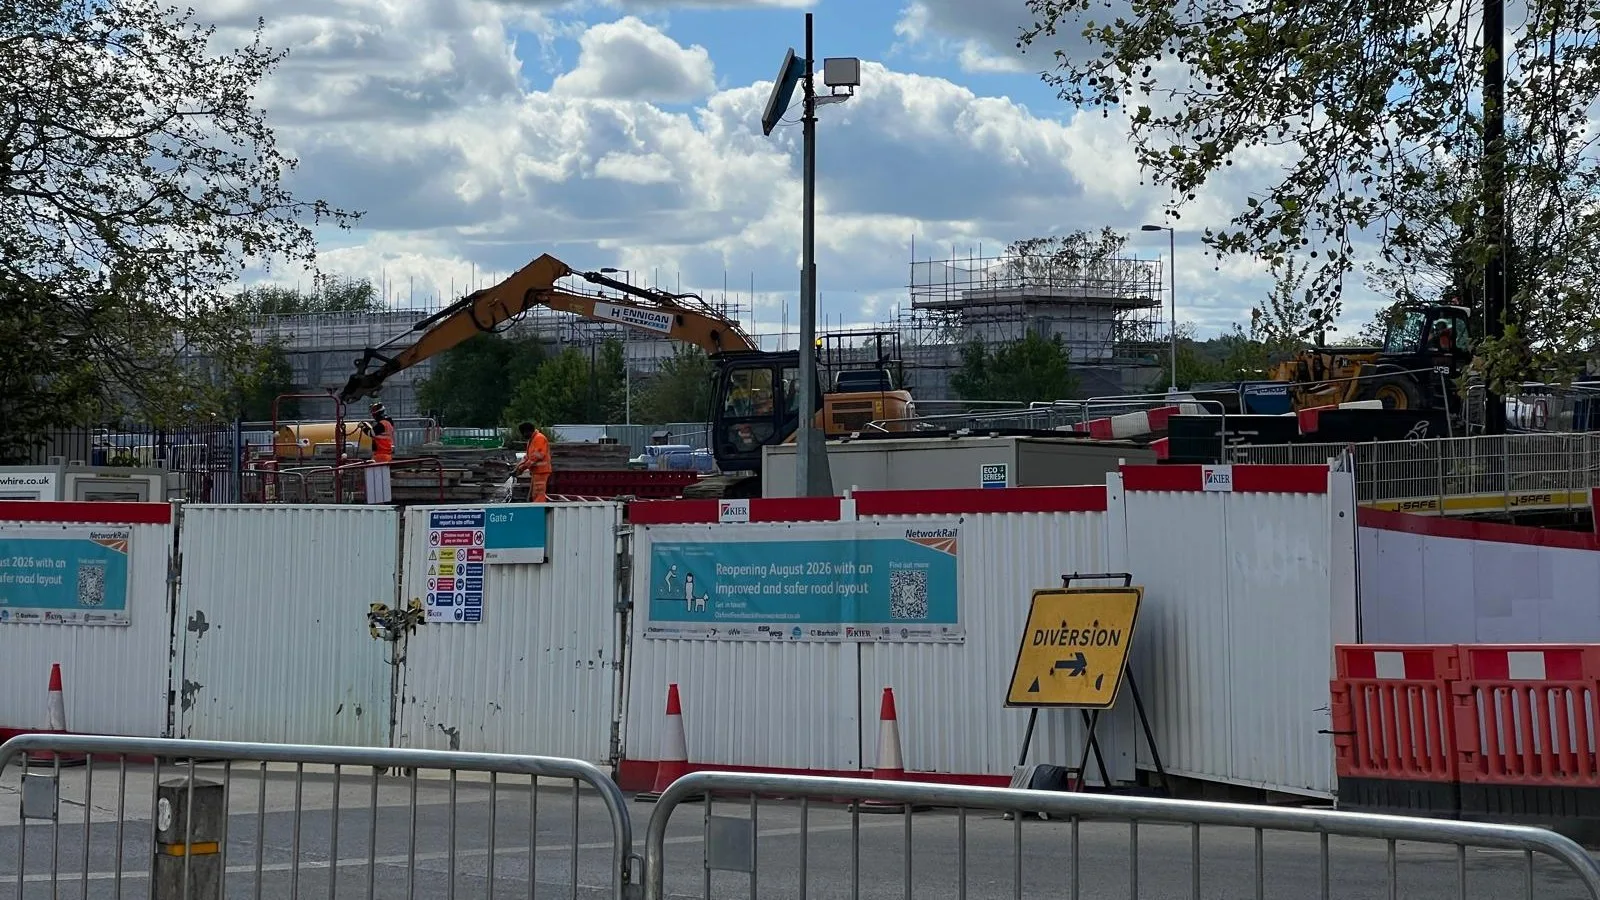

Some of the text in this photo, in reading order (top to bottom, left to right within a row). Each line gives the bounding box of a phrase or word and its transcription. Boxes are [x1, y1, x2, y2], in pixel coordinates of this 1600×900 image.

[611, 307, 669, 324] HENNIGAN
[983, 466, 998, 474] ECO
[1212, 474, 1230, 484] KIER
[1392, 500, 1437, 512] J-SAFE
[1511, 494, 1551, 506] J-SAFE
[729, 506, 747, 516] KIER
[489, 512, 514, 523] Gate 7
[89, 531, 129, 539] NetworkRail
[905, 528, 958, 538] NetworkRail
[12, 556, 34, 568] 2026
[35, 557, 54, 569] with
[55, 560, 66, 568] an
[716, 561, 873, 579] Reopening August 2026 with an
[15, 572, 36, 584] road
[36, 573, 63, 587] layout
[715, 581, 869, 597] improved and safer road layout
[1033, 629, 1121, 646] DIVERSION
